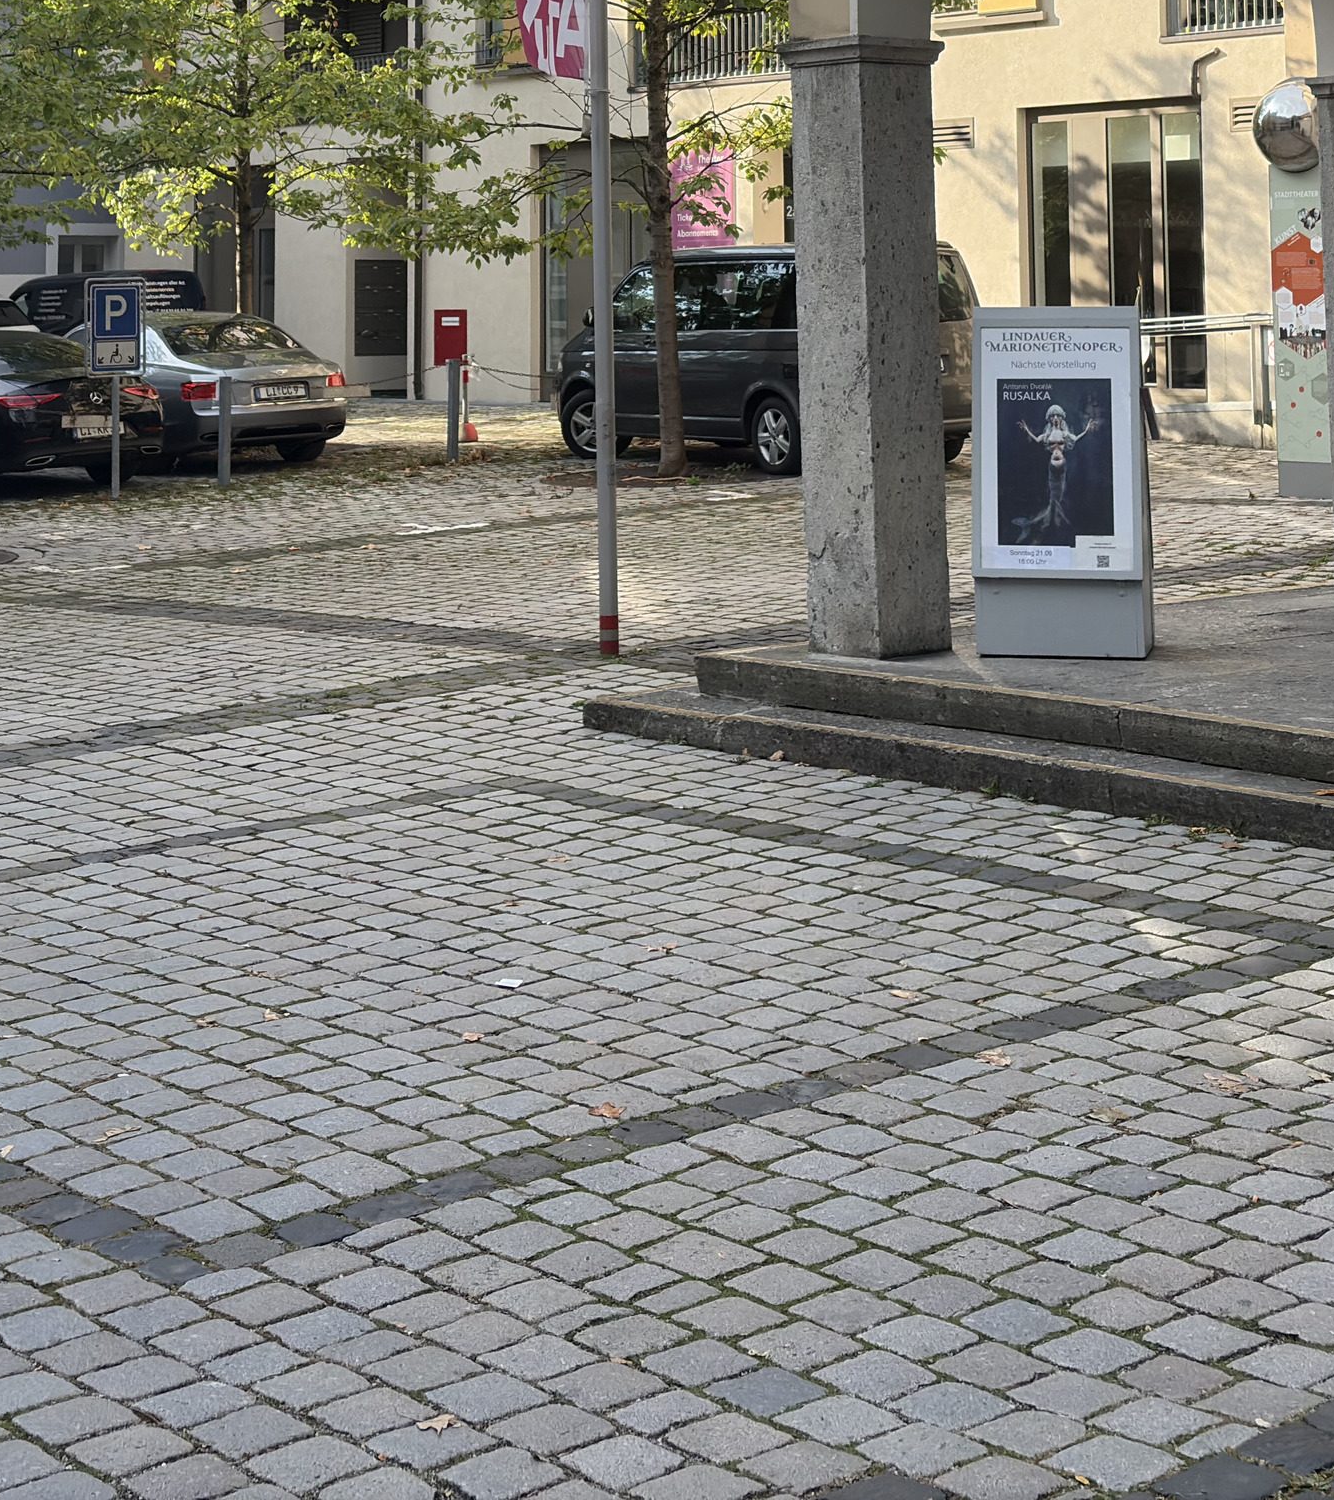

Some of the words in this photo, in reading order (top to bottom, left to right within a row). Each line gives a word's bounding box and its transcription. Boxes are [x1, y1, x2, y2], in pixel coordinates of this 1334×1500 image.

[1274, 190, 1319, 199] STADTTHEATER
[677, 229, 719, 238] Abonnements
[1274, 224, 1297, 245] KUNST
[105, 294, 128, 331] P
[1002, 332, 1072, 342] LINDAUER
[985, 340, 1123, 353] MARIONETTENOPER
[1011, 360, 1046, 369] Nächste
[1047, 360, 1097, 370] Vorstellung
[1003, 391, 1051, 401] RUSALKA
